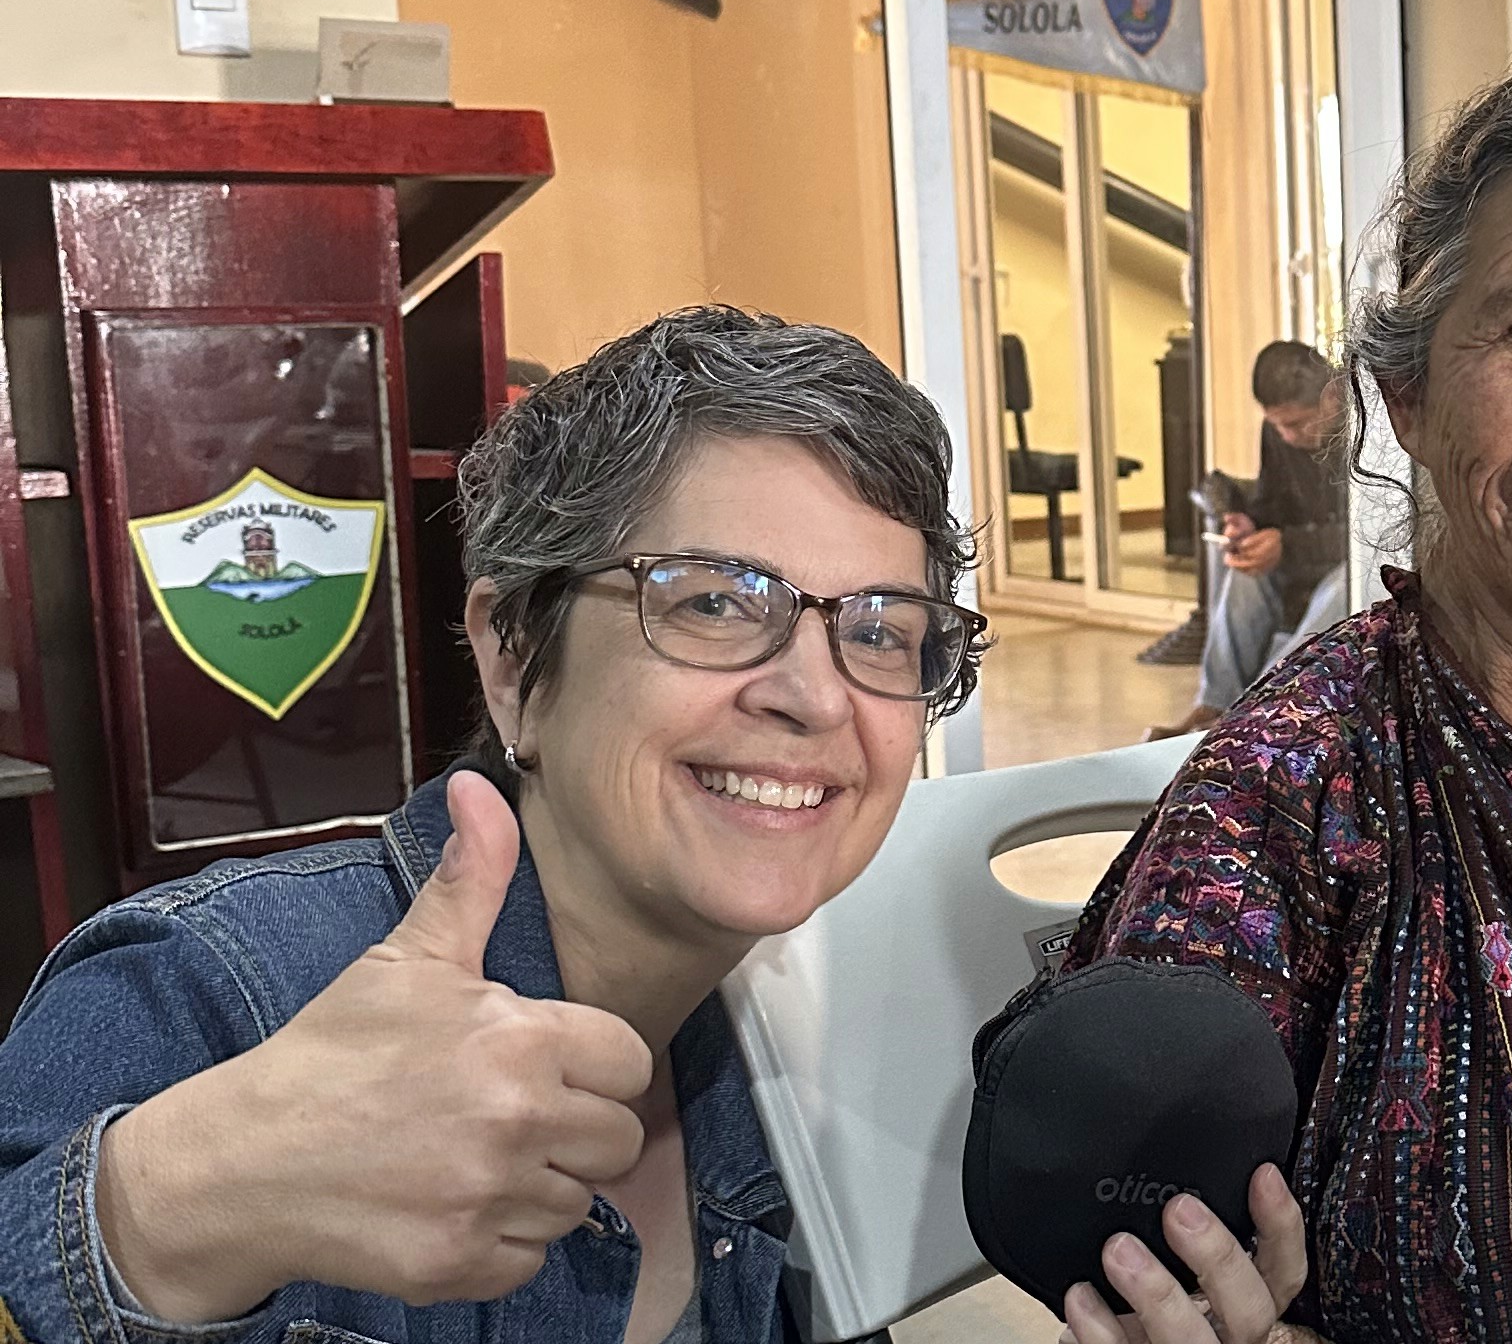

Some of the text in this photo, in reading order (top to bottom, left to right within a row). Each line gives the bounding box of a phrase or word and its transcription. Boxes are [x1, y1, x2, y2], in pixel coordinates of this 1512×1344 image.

[982, 1, 1084, 34] SOLOLA
[181, 503, 337, 544] RESERVAS MILITARES
[1095, 1173, 1201, 1204] otico
